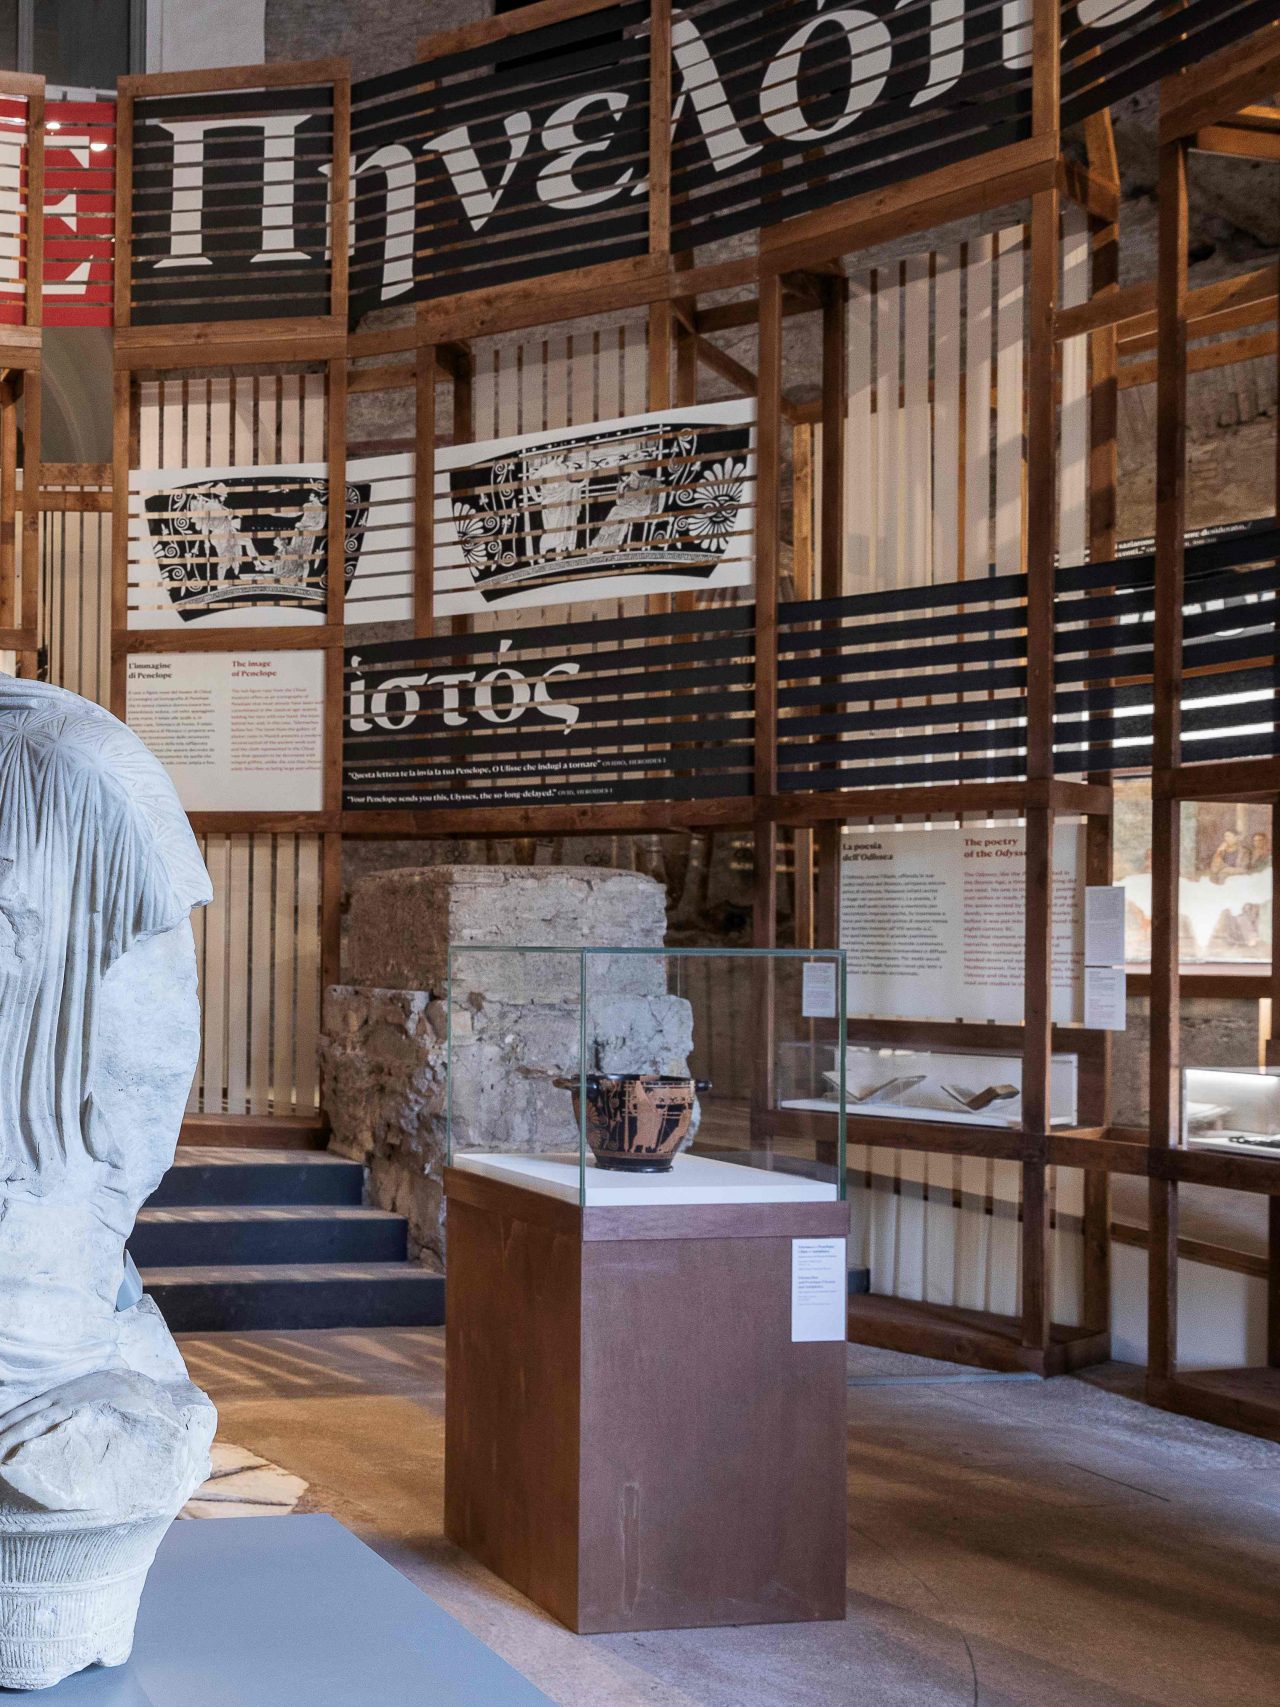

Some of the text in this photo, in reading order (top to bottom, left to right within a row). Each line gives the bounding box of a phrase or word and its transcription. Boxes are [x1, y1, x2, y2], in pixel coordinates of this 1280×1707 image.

[232, 660, 272, 668] The image
[137, 672, 172, 680] Penelope
[241, 670, 277, 678] Penelope
[376, 770, 400, 778] lettera
[416, 768, 434, 776] invia
[456, 766, 491, 775] Penelope,
[500, 764, 522, 772] Ulisse
[538, 762, 562, 770] indugi
[366, 795, 397, 804] Penelope
[434, 794, 450, 802] this,
[964, 838, 1018, 847] The poetry
[854, 842, 882, 852] poesia
[964, 850, 974, 858] of
[976, 850, 992, 858] the
